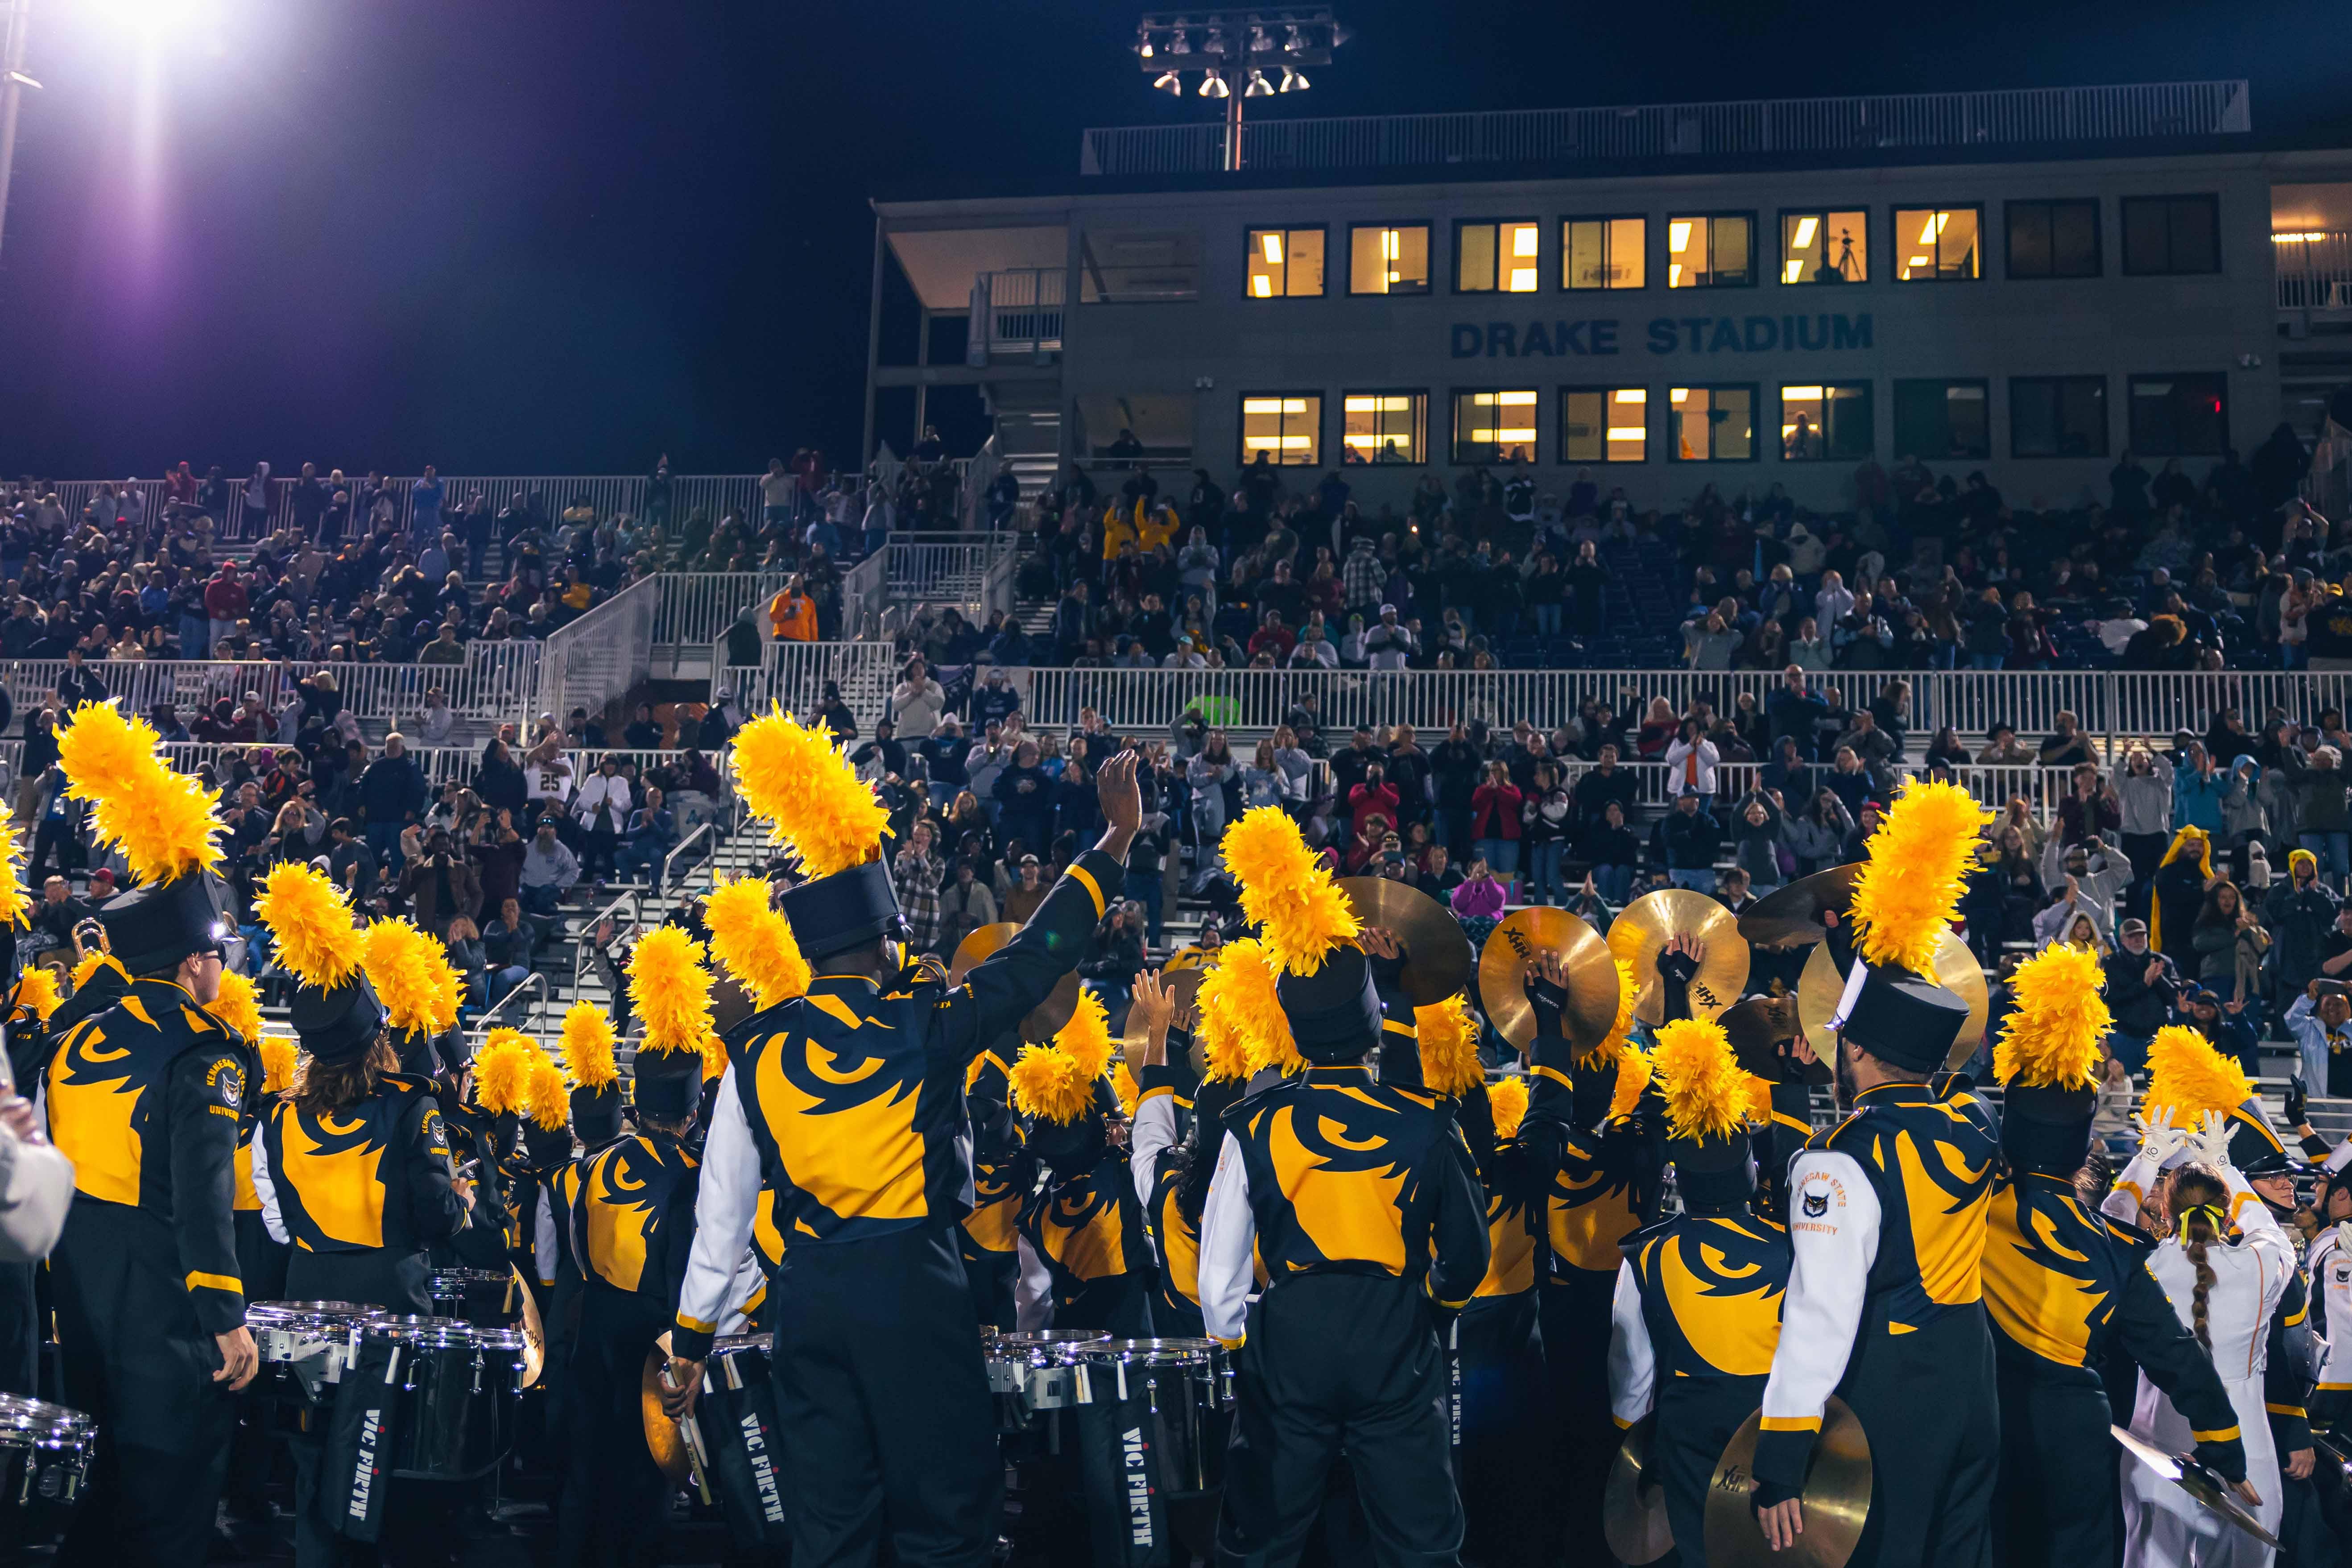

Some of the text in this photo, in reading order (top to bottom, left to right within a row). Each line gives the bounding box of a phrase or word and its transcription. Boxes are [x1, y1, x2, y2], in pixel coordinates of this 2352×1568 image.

[1451, 314, 1873, 359] DRAKE STADIUM
[541, 774, 560, 791] 25
[1502, 927, 1531, 960] HHX
[207, 1059, 237, 1086] KENNESAW
[1831, 1178, 1846, 1207] STATE
[349, 1410, 385, 1518] VIC FIRTH
[741, 1412, 784, 1522] VIC FIRTH
[1122, 1427, 1155, 1544] VIC FIRTH
